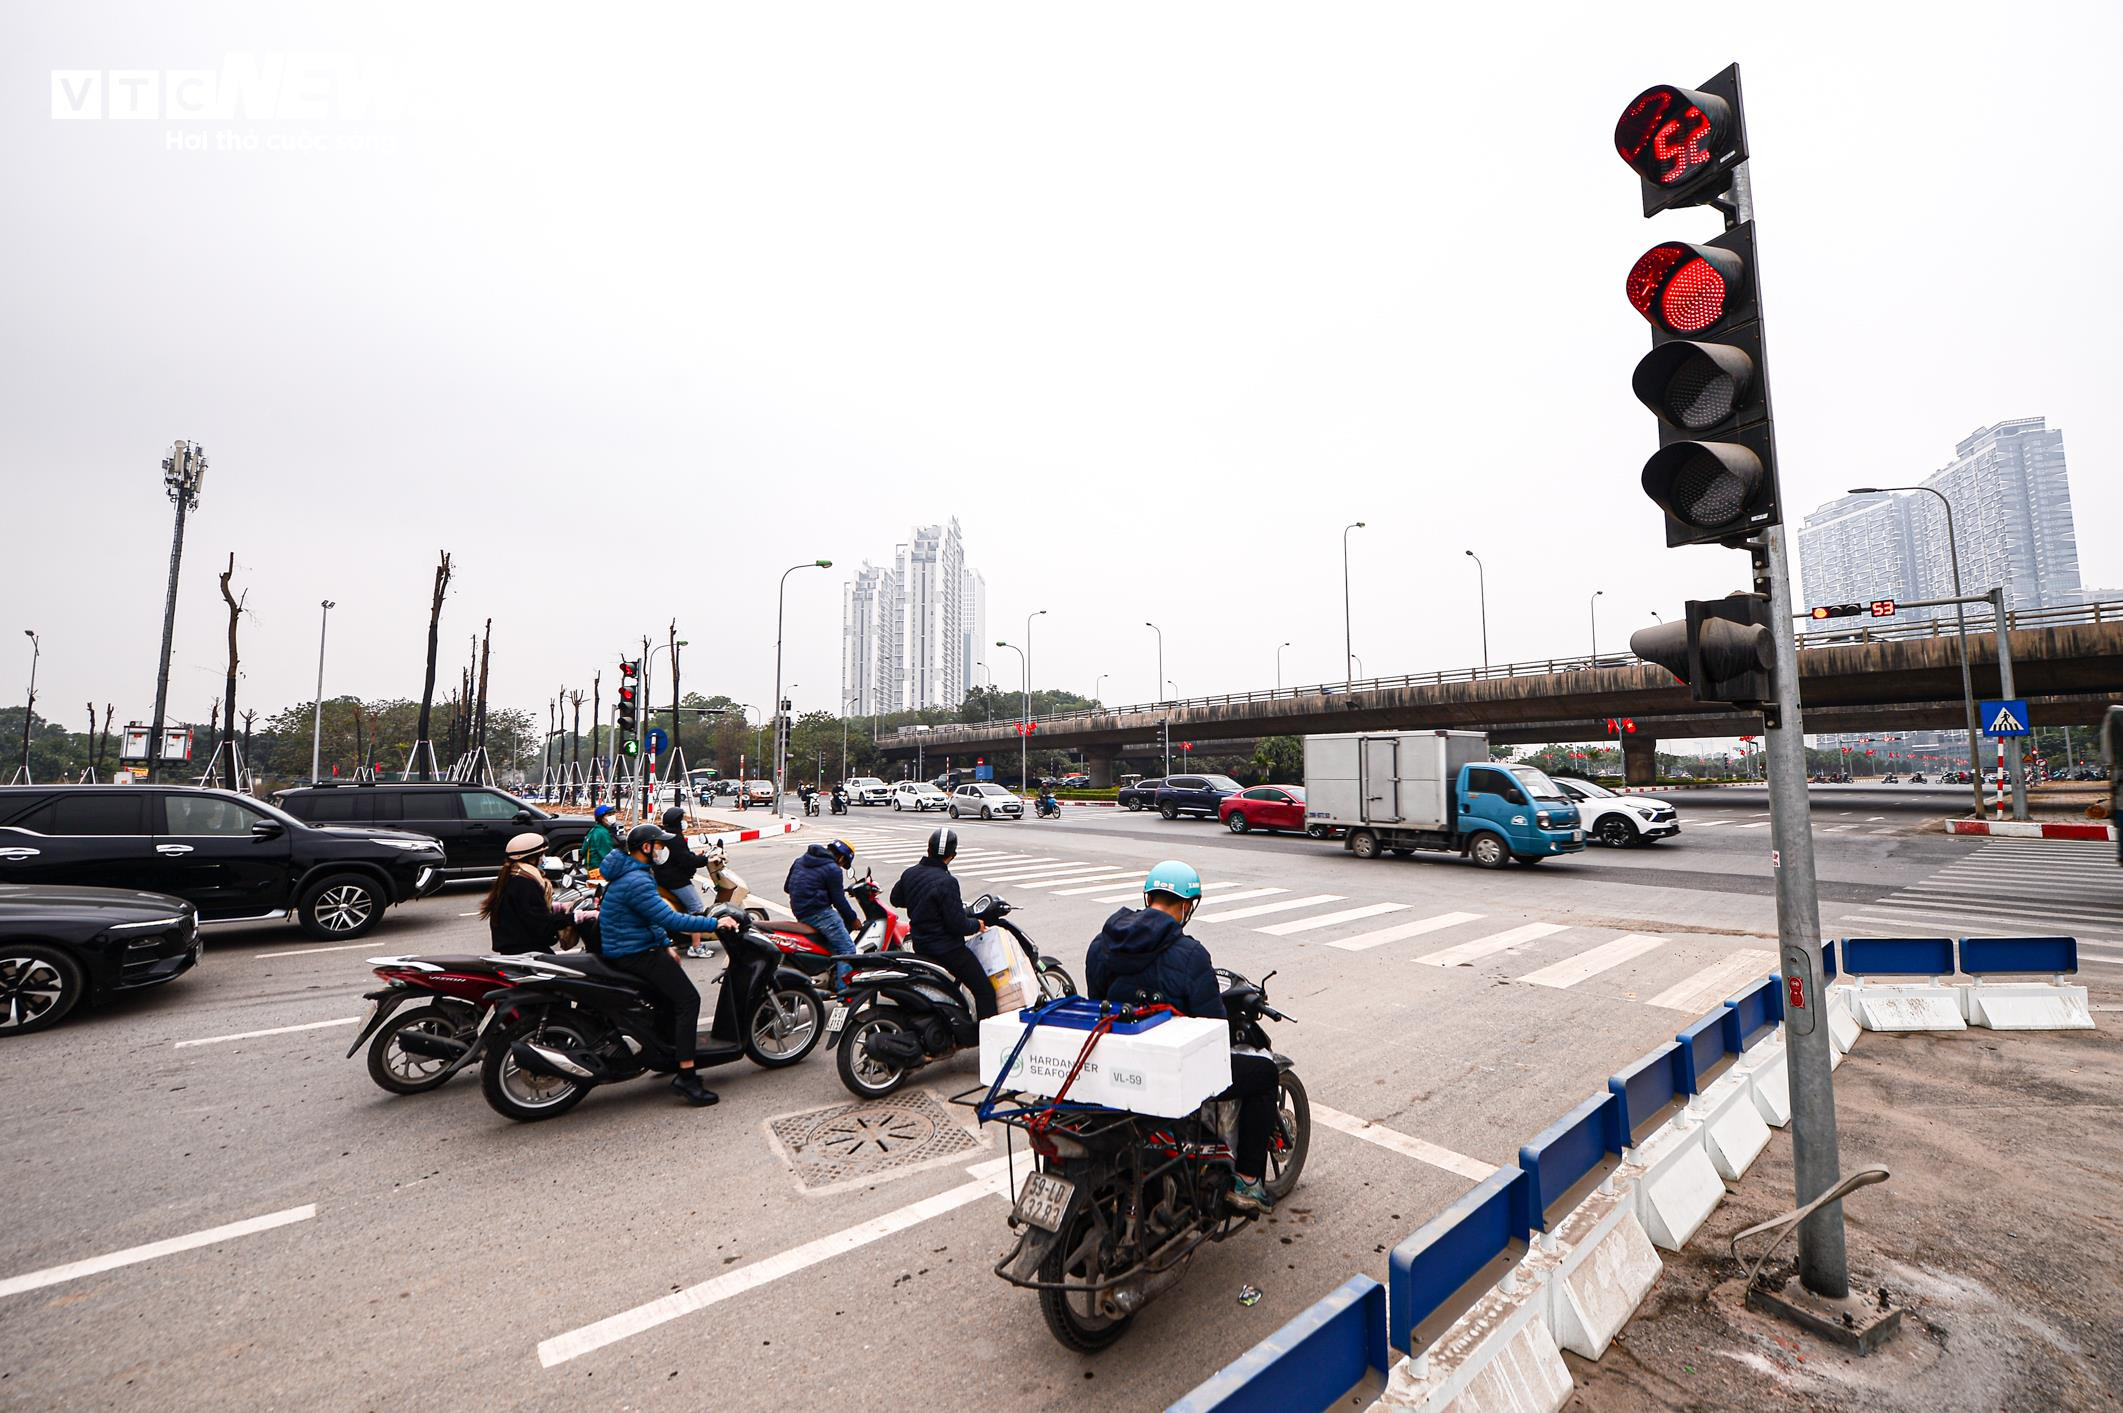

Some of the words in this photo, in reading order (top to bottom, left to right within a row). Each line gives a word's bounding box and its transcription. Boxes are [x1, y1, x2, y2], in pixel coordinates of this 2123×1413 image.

[1872, 601, 1894, 616] 53
[1029, 1054, 1099, 1073] HARDANER
[1113, 1072, 1142, 1086] VL-59
[1029, 1175, 1067, 1204] 59-LD
